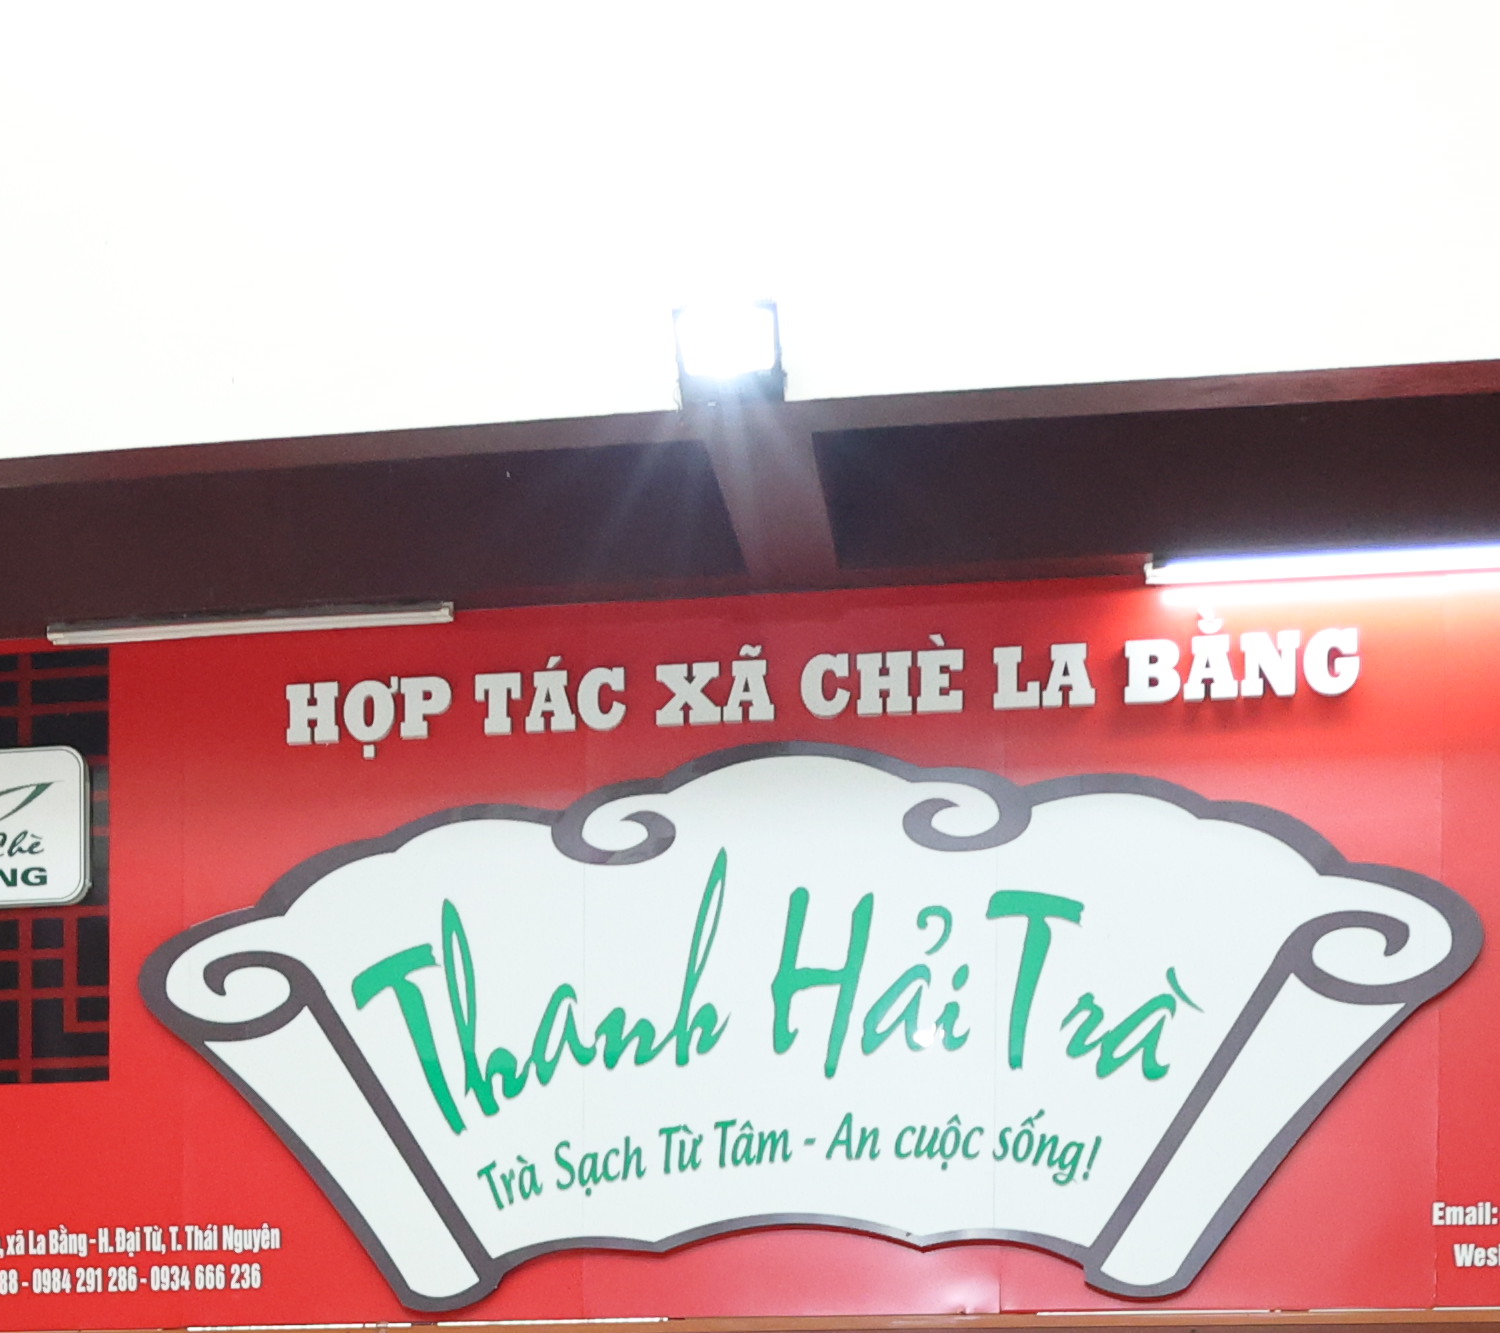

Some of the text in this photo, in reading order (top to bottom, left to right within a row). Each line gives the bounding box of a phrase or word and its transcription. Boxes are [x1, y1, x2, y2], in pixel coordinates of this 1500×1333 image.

[285, 608, 1360, 759] HỢP TÁC XÃ CHÈ LA BẰNG
[352, 846, 1204, 1135] Thanh Hải Trà
[477, 1155, 543, 1210] Trà
[555, 1135, 646, 1197] Sạch
[659, 1124, 703, 1174] Từ
[714, 1119, 792, 1168] Tâm
[826, 1112, 880, 1160] An
[895, 1114, 984, 1170] cuộc
[993, 1109, 1102, 1186] sống!
[6, 1229, 25, 1256] xã
[28, 1230, 46, 1255] La
[143, 1225, 166, 1255] Từ,
[169, 1226, 183, 1251] T.
[185, 1224, 218, 1250] Thái
[222, 1223, 281, 1253] Nguyên
[1432, 1202, 1499, 1226] Email:
[32, 1267, 71, 1294] 0984
[76, 1266, 103, 1293] 291
[107, 1266, 138, 1292] 286
[150, 1264, 190, 1292] 0934
[194, 1263, 225, 1290] 666
[230, 1262, 261, 1290] 236
